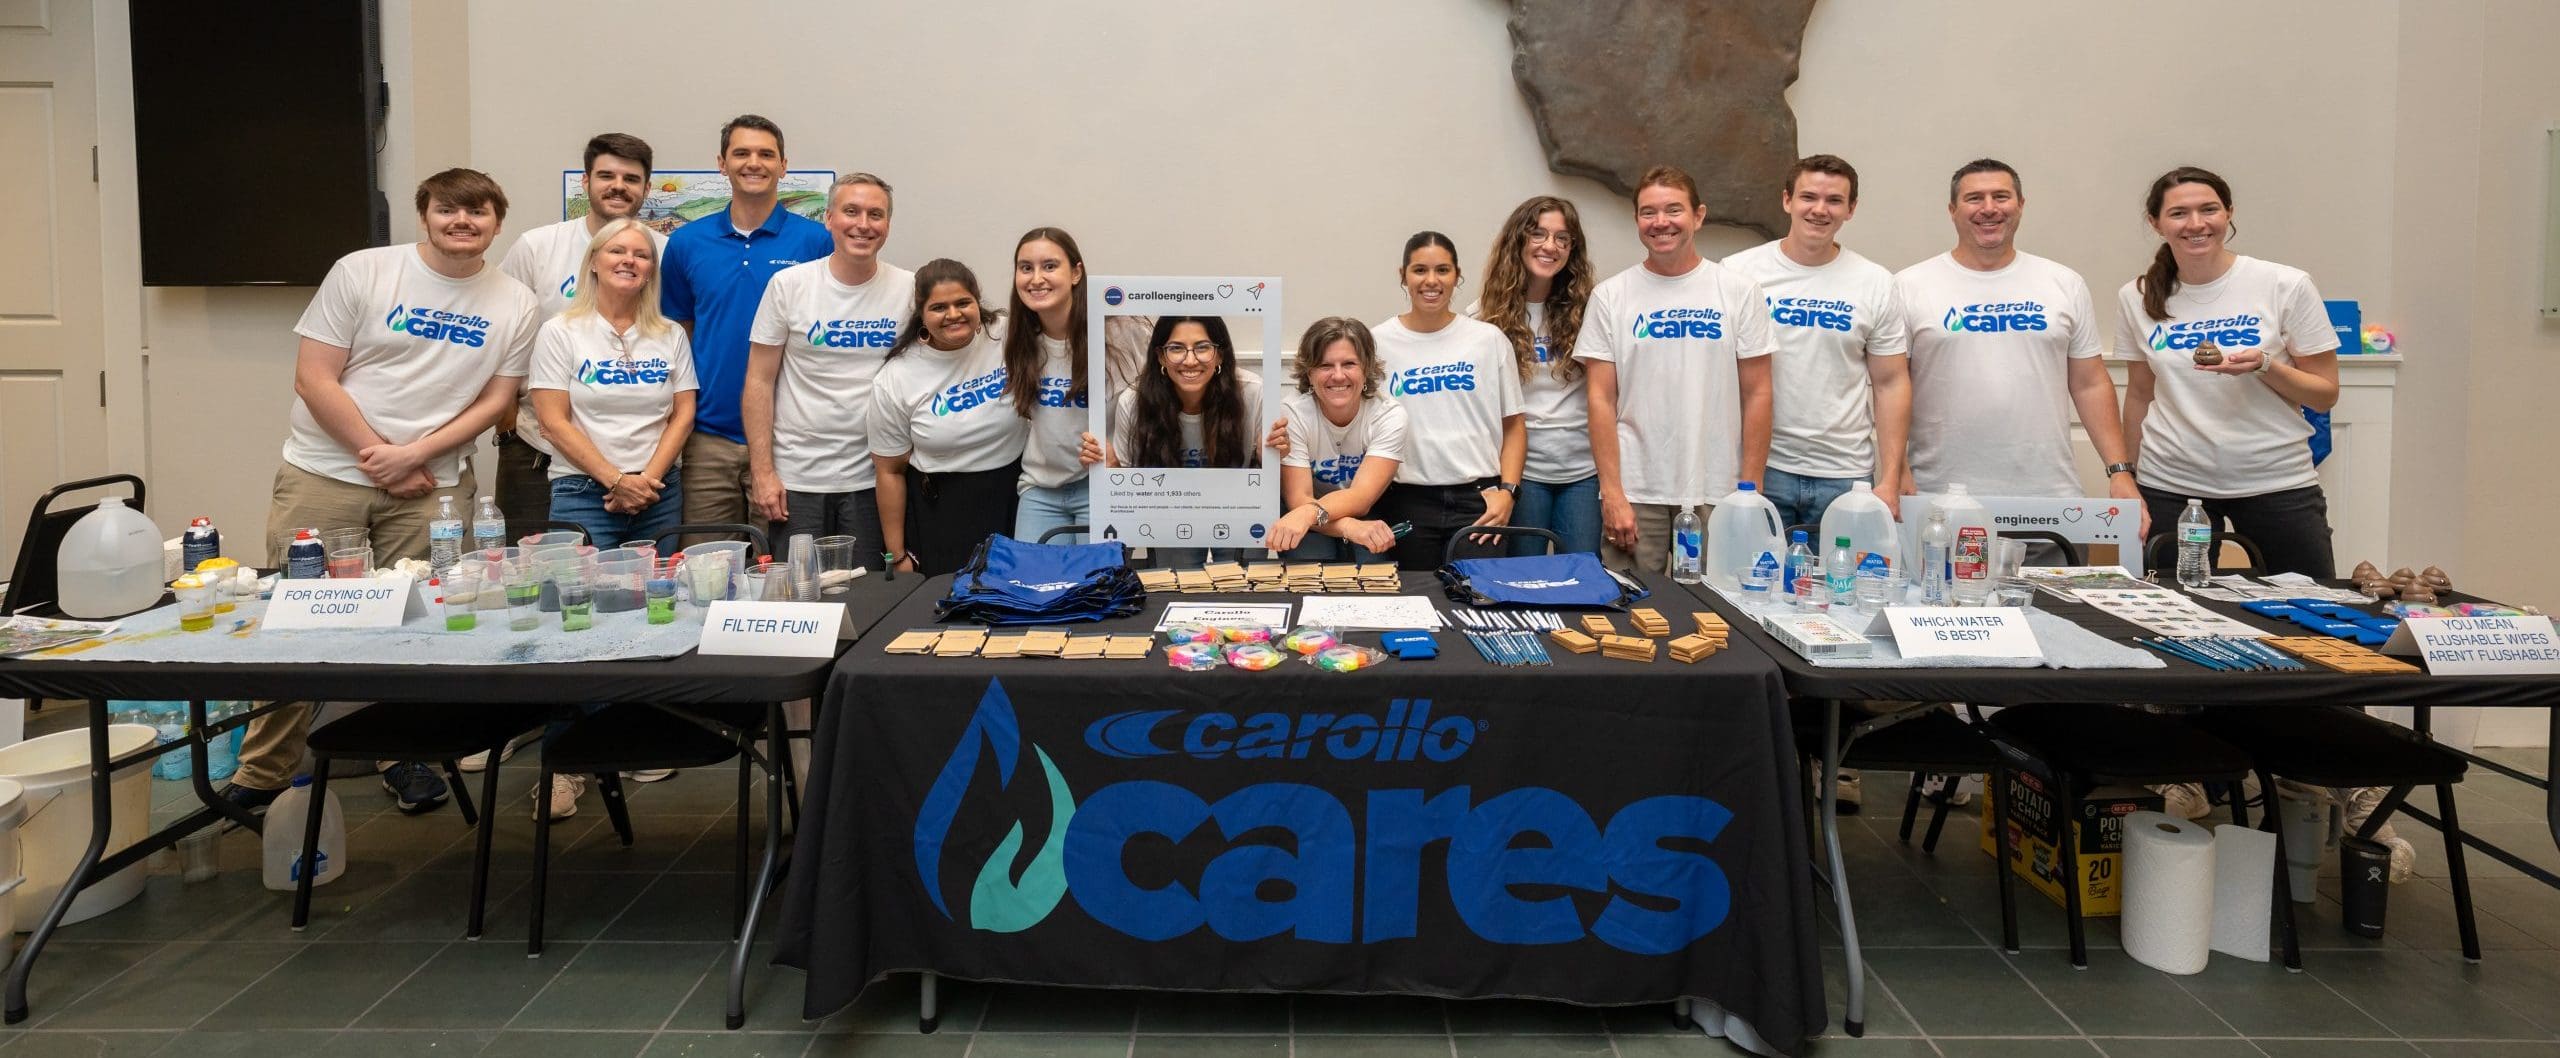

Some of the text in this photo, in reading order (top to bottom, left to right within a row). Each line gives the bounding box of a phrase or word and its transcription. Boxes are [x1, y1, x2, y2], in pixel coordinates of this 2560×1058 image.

[1128, 291, 1215, 303] carolloengineers
[1797, 299, 1854, 313] carollo
[1984, 301, 2044, 312] carollo
[432, 310, 490, 329] carollo
[1667, 308, 1722, 321] carollo
[1774, 307, 1853, 332] cares
[2193, 314, 2260, 331] carollo
[845, 318, 897, 329] carollo
[1649, 319, 1723, 339] cares
[1962, 313, 2048, 333] cares
[405, 317, 486, 348] cares
[824, 330, 897, 348] cares
[2166, 327, 2262, 350] cares
[615, 358, 668, 369] carollo
[1421, 361, 1474, 375] carollo
[596, 368, 670, 385] cares
[1402, 373, 1475, 395] cares
[285, 589, 394, 600] FOR CRYING OUT
[310, 603, 360, 614] CLOUD!
[722, 618, 819, 634] FILTER FUN!
[1910, 616, 2004, 627] WHICH WATER
[2441, 618, 2519, 631] YOU MEAN,
[1935, 630, 1990, 641] IS BEST?
[2425, 633, 2549, 646] FLUSHABLE WIPES
[2429, 648, 2560, 661] AREN'T FLUSHABLE?
[2010, 779, 2052, 819] POTATO
[2017, 802, 2042, 821] CHIP
[2100, 817, 2123, 833] POT
[1062, 780, 1735, 955] cares
[2088, 857, 2111, 882] 20
